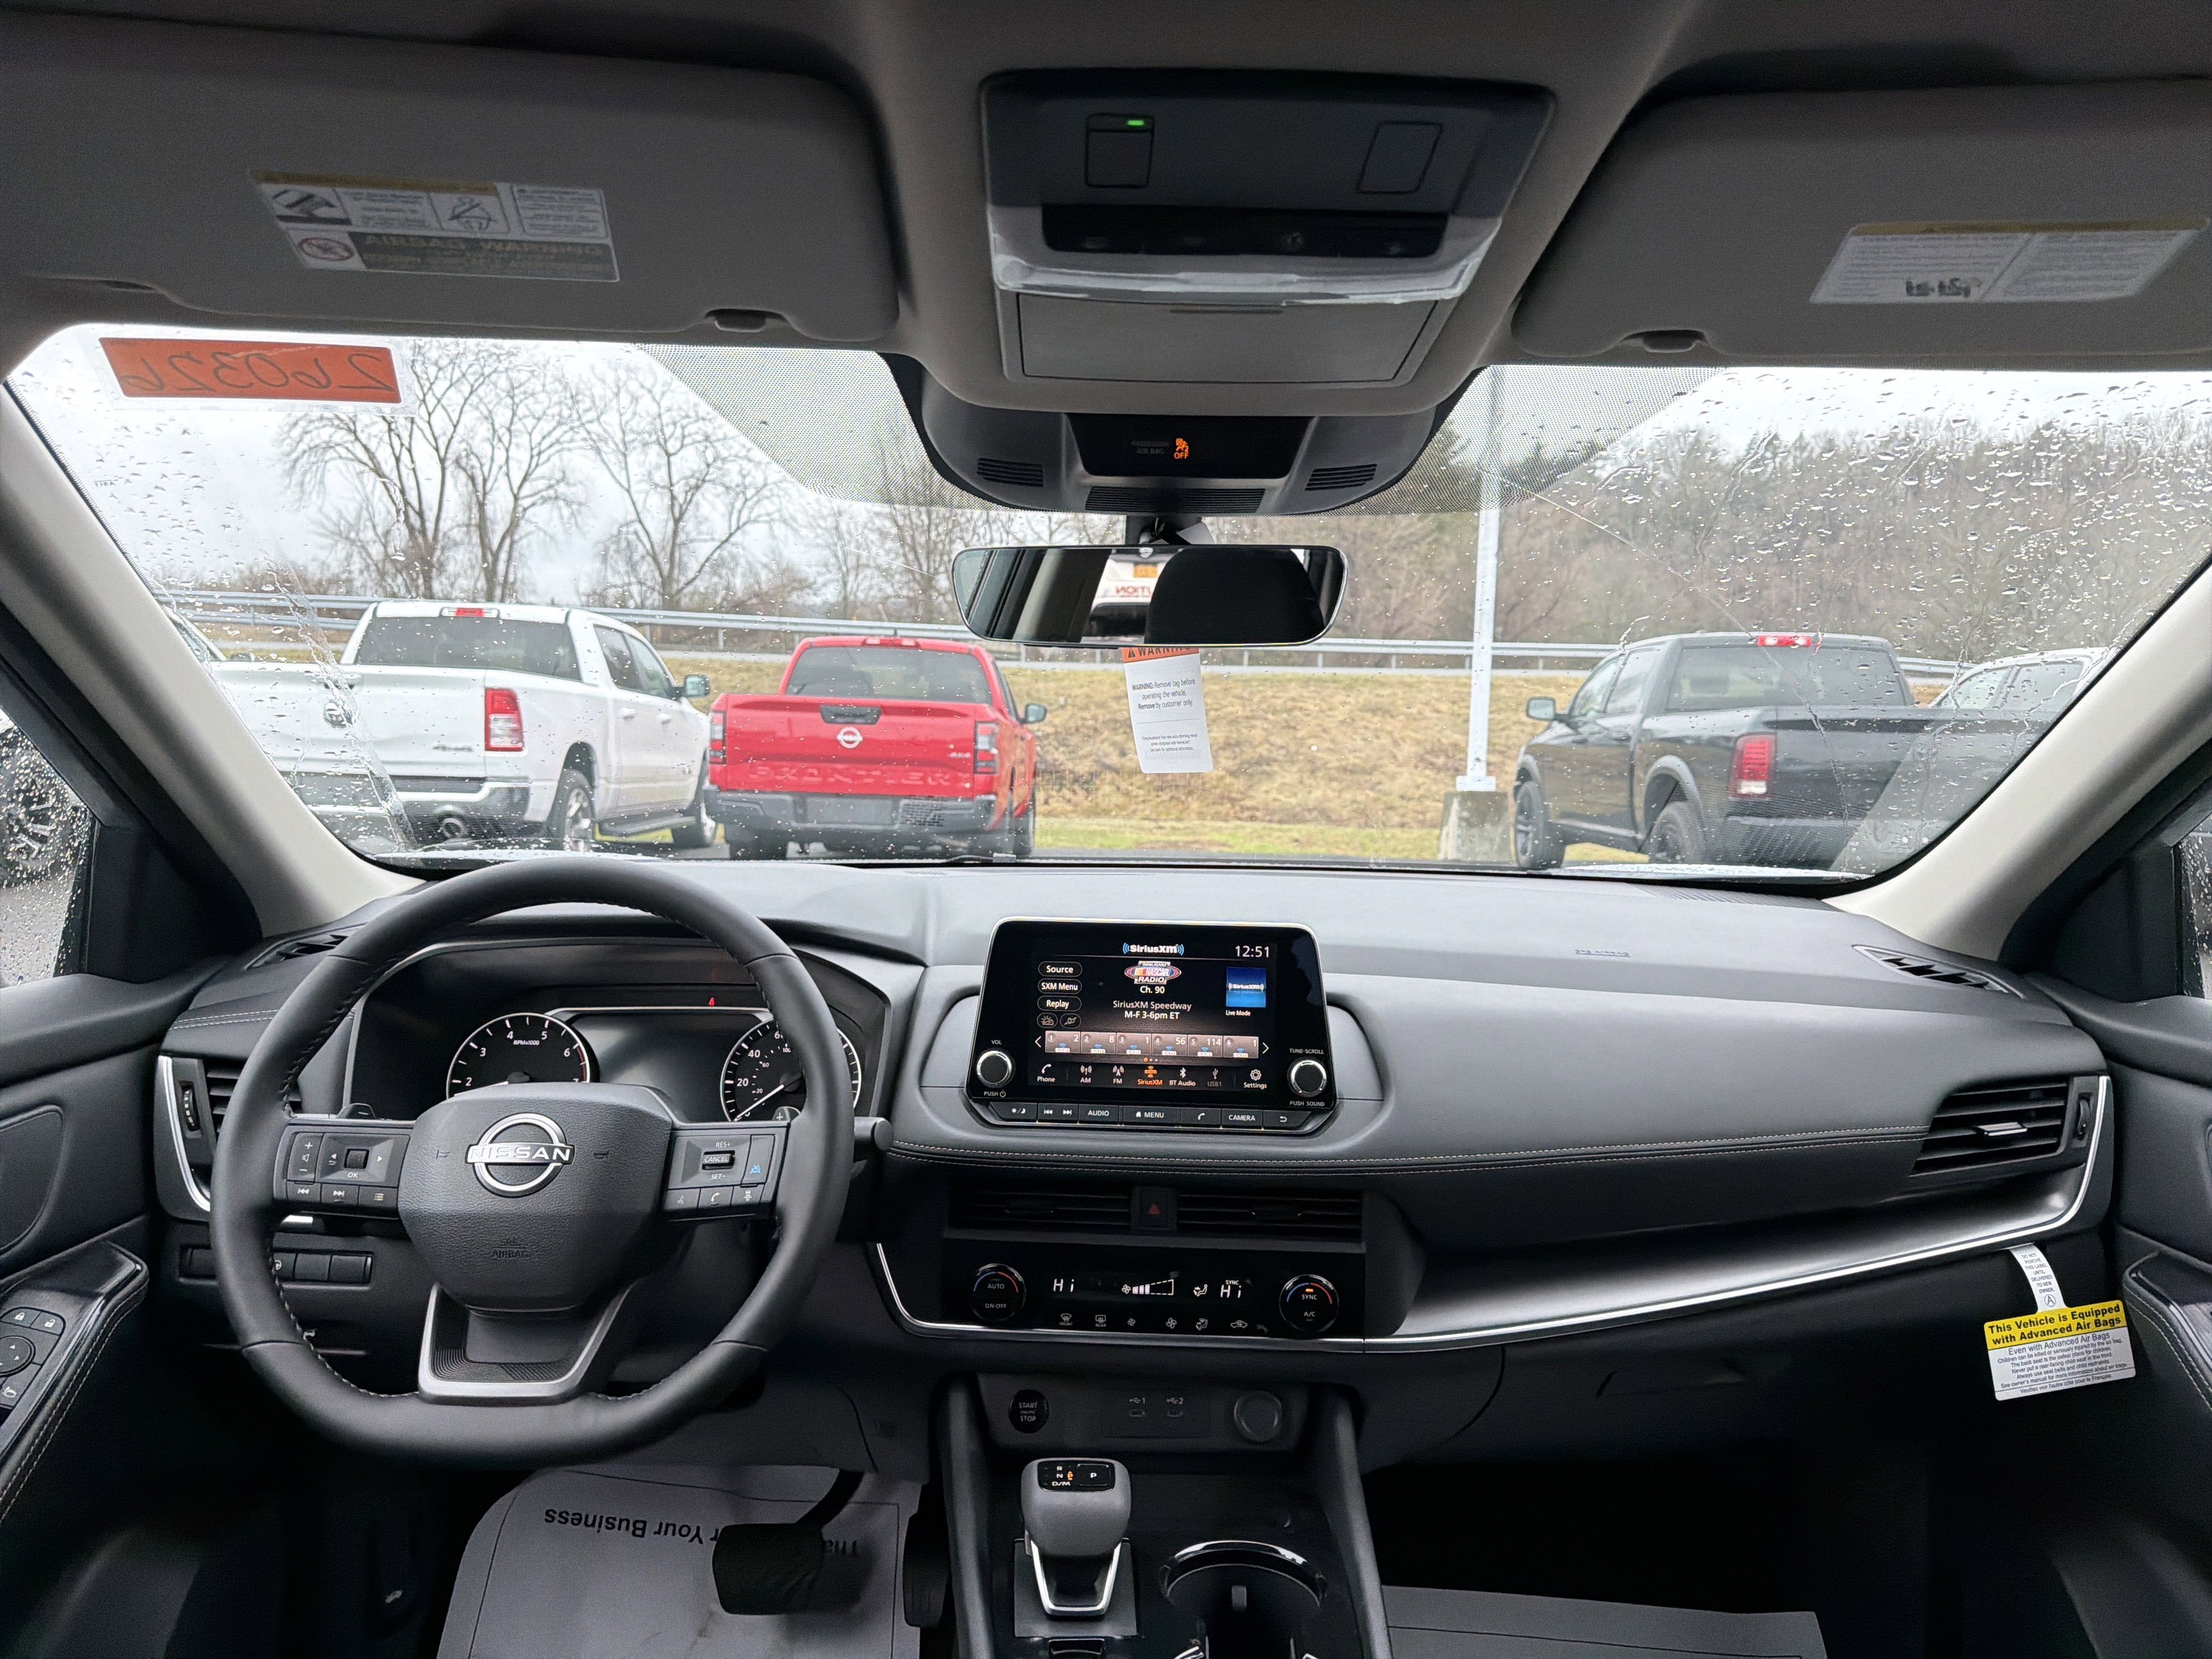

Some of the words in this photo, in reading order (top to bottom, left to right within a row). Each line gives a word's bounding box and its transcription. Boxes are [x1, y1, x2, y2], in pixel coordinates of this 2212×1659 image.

[1132, 682, 1154, 691] WARNING:
[1181, 678, 1196, 686] before
[1142, 692, 1162, 701] operating
[1235, 945, 1270, 958] 12:51
[1146, 968, 1170, 976] NASCAR
[1058, 983, 1078, 991] Menu
[1140, 986, 1153, 994] Ch.
[1046, 1000, 1069, 1009] Replay
[1113, 1001, 1148, 1009] SiriusXM
[1150, 1001, 1192, 1011] Speedway
[1142, 1012, 1167, 1020] 3-6pm
[506, 1031, 514, 1039] 4
[541, 1031, 548, 1040] 5
[1175, 1037, 1186, 1045] 56
[1206, 1038, 1221, 1046] 114
[480, 1048, 486, 1057] 3
[563, 1048, 571, 1057] 6
[748, 1049, 760, 1058] 40
[465, 1077, 472, 1086] 2
[737, 1078, 749, 1087] 20
[1243, 1081, 1267, 1090] Settings
[471, 1146, 571, 1160] NISSAN
[1053, 1278, 1074, 1292] Hi
[1220, 1284, 1242, 1299] Hi
[2047, 1295, 2055, 1305] A
[1988, 1322, 2012, 1334] This
[2015, 1314, 2055, 1329] Vehicle
[2058, 1312, 2067, 1322] is
[2071, 1304, 2120, 1321] Equipped
[1992, 1333, 2015, 1345] with
[2019, 1323, 2072, 1340] Advanced
[2075, 1320, 2091, 1331] Air
[2094, 1315, 2120, 1329] Bags
[2008, 1346, 2026, 1355] Even
[2028, 1343, 2042, 1352] with
[2044, 1337, 2079, 1349] Advanced
[2092, 1331, 2109, 1341] Bags
[2016, 1372, 2033, 1380] Always
[544, 1509, 647, 1538] Business
[654, 1521, 703, 1544] Your
